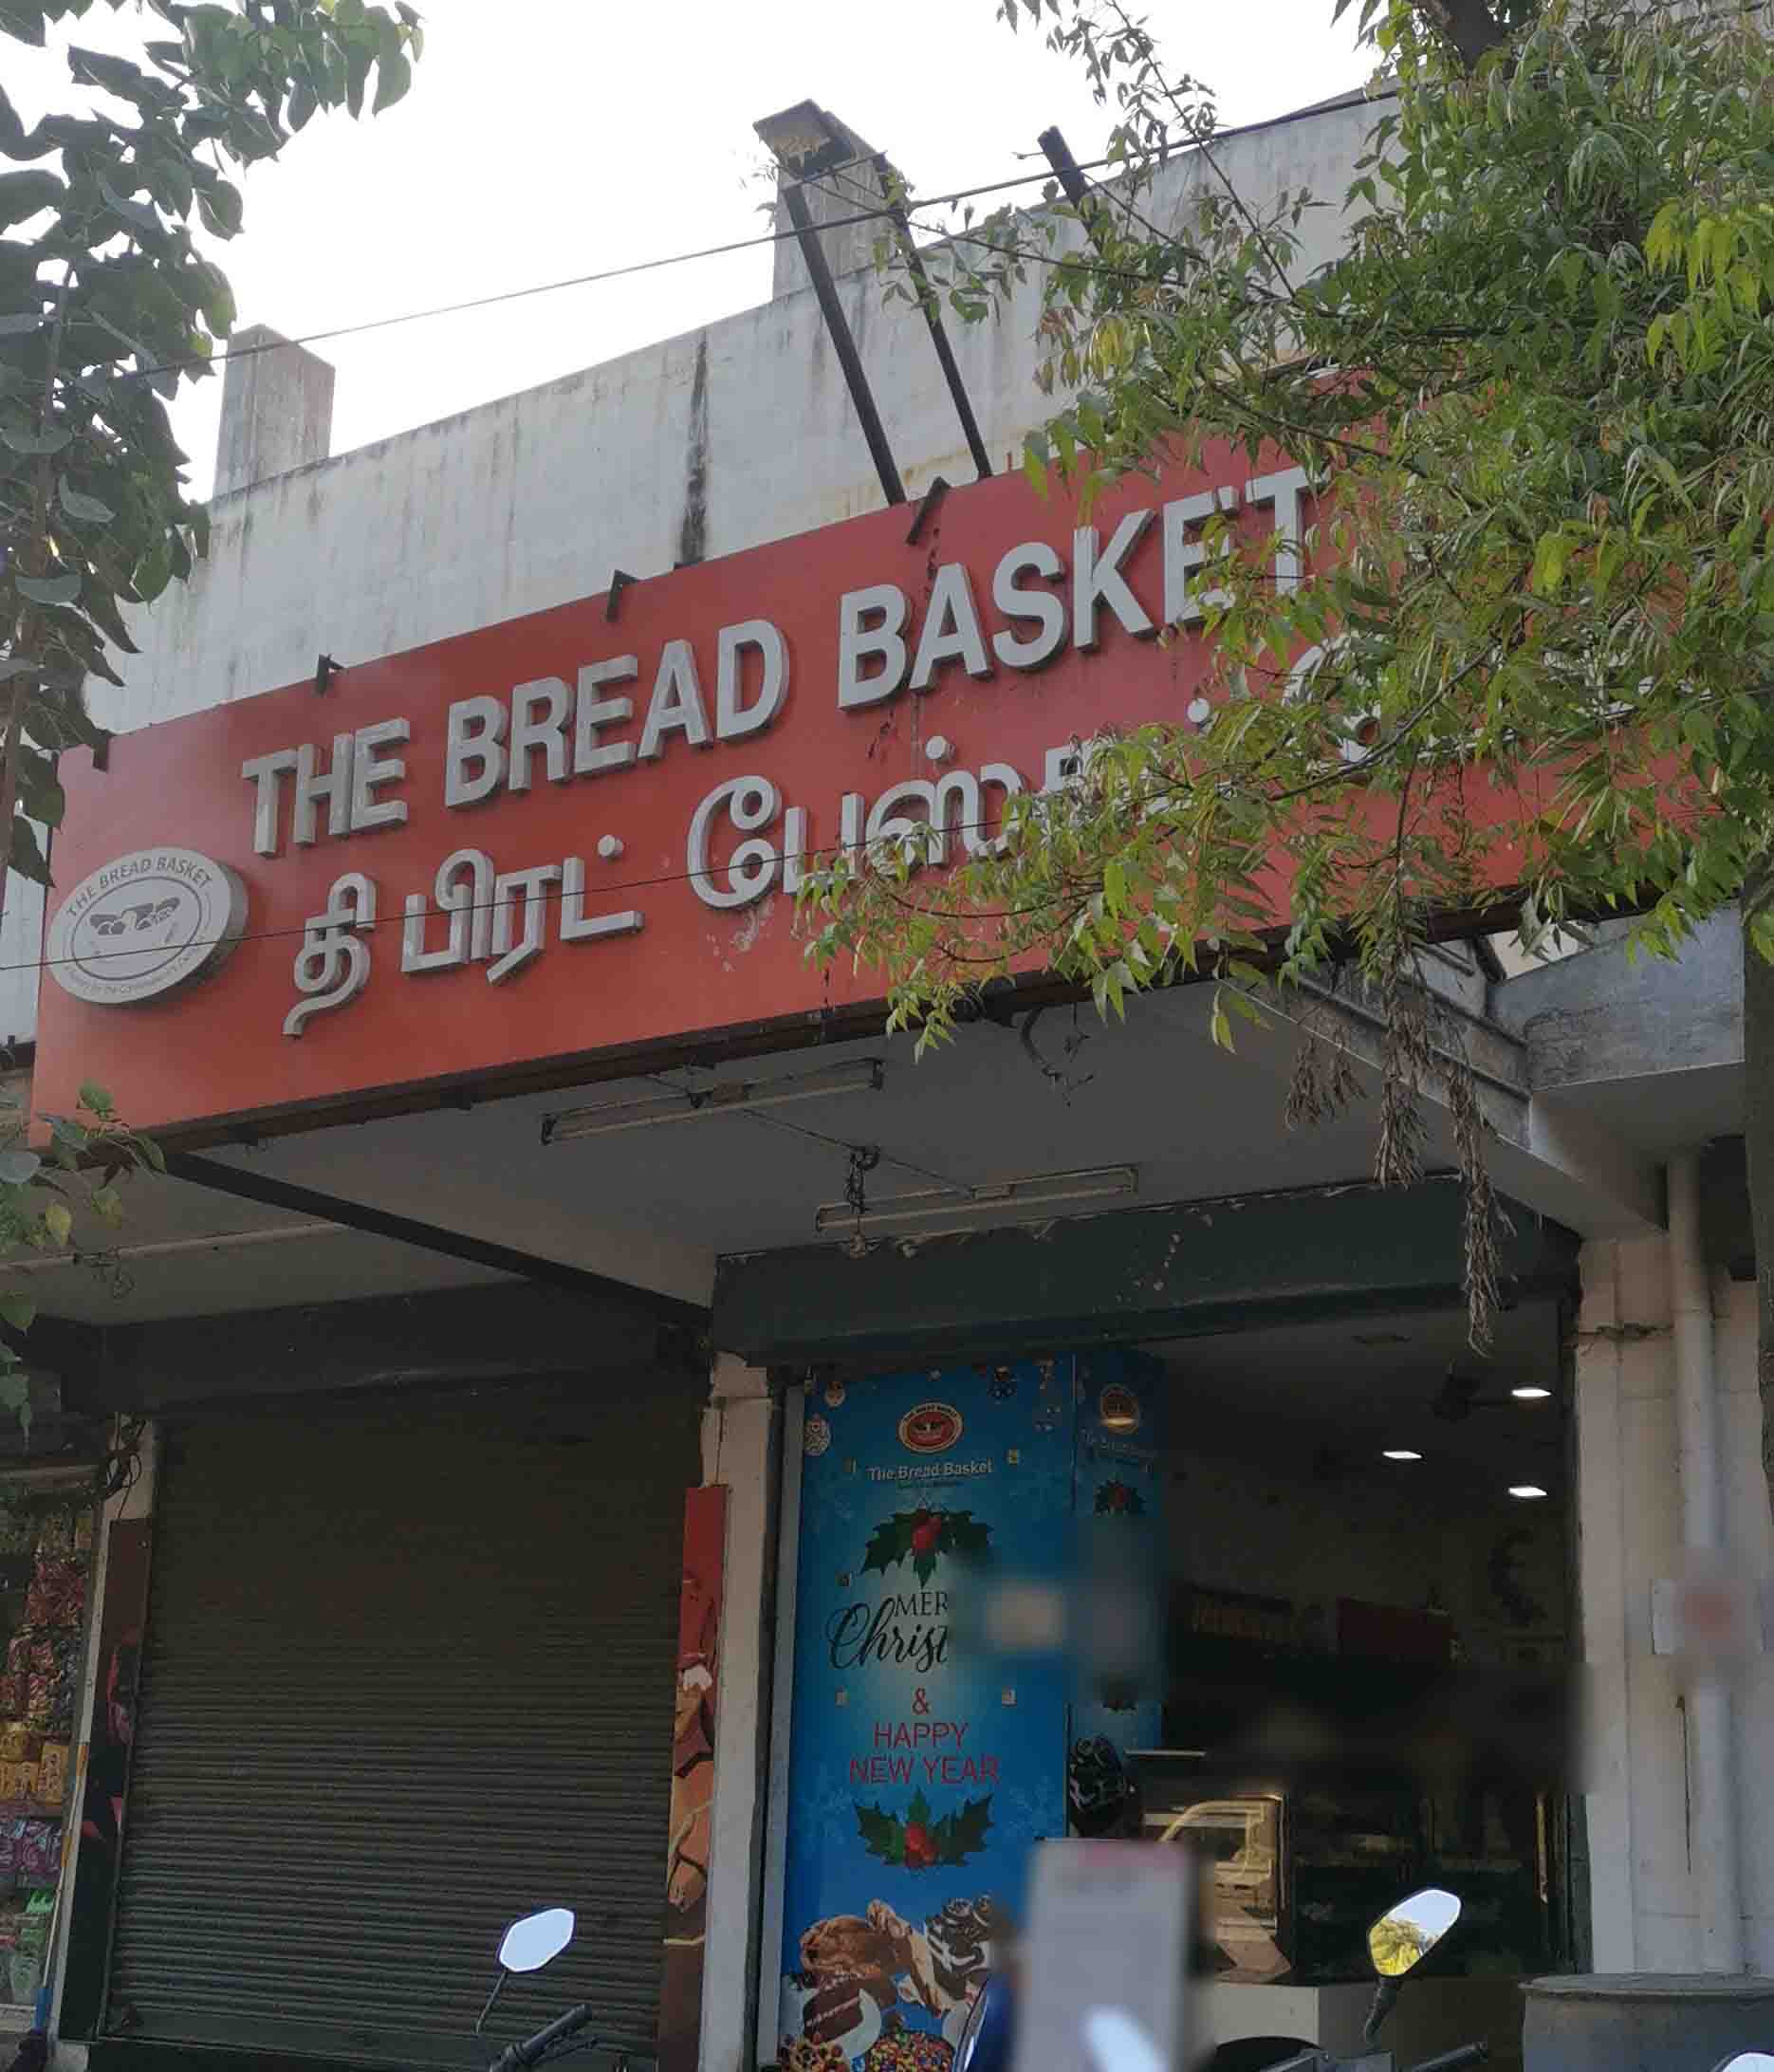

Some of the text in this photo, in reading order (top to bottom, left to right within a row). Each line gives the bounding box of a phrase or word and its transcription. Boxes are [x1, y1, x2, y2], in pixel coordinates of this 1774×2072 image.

[241, 716, 411, 858] THE
[443, 619, 792, 809] BREAD
[837, 465, 1331, 710] BASKET
[66, 856, 213, 917] THE BREAD BASKET
[282, 871, 378, 1038] தி
[400, 835, 646, 985] பிரட்
[865, 1466, 895, 1481] The
[943, 1458, 993, 1475] Basket
[912, 1687, 931, 1714] &
[874, 1722, 969, 1749] HAPPY
[849, 1755, 1001, 1785] NEW YEAR
